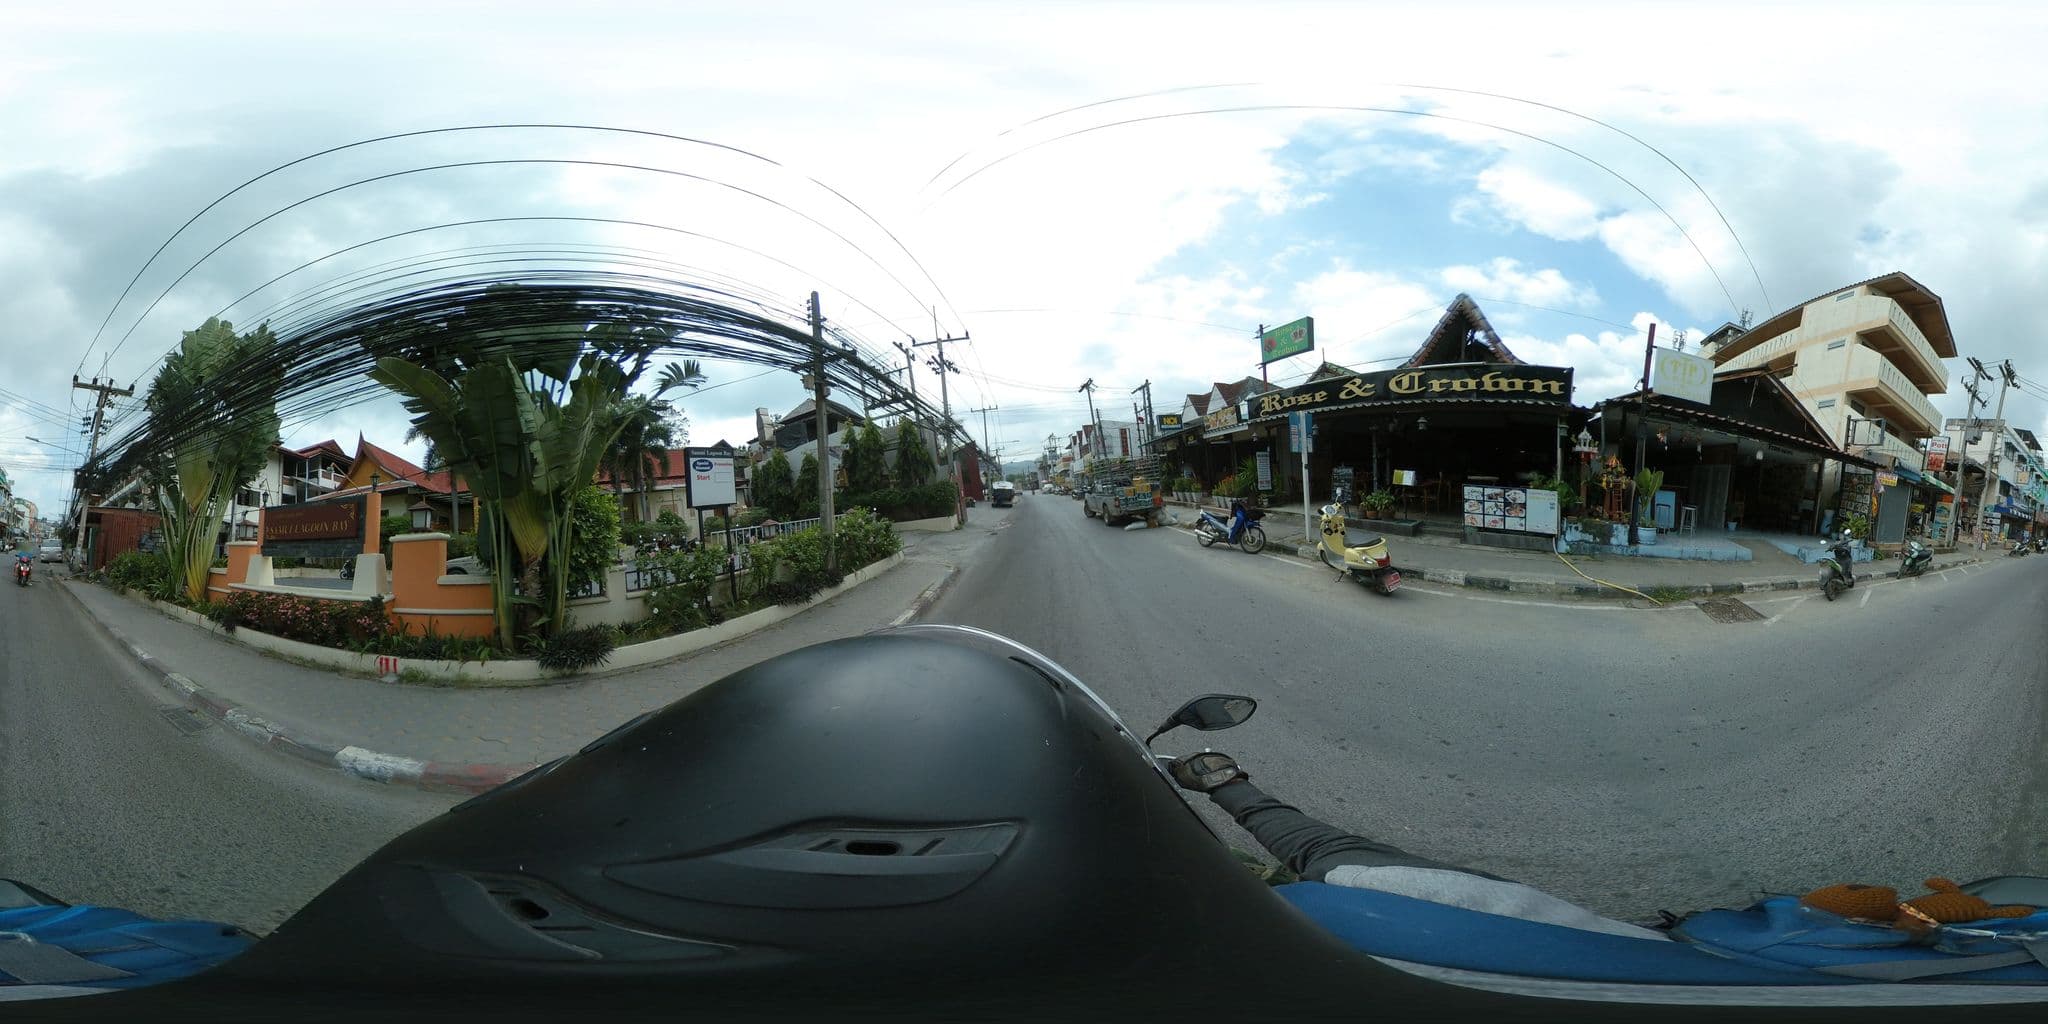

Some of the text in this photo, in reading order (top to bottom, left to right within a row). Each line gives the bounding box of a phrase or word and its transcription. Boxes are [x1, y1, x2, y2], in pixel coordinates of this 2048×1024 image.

[1260, 371, 1565, 417] Rose & Crown
[294, 521, 329, 534] LAGOON
[331, 519, 350, 532] BAY
